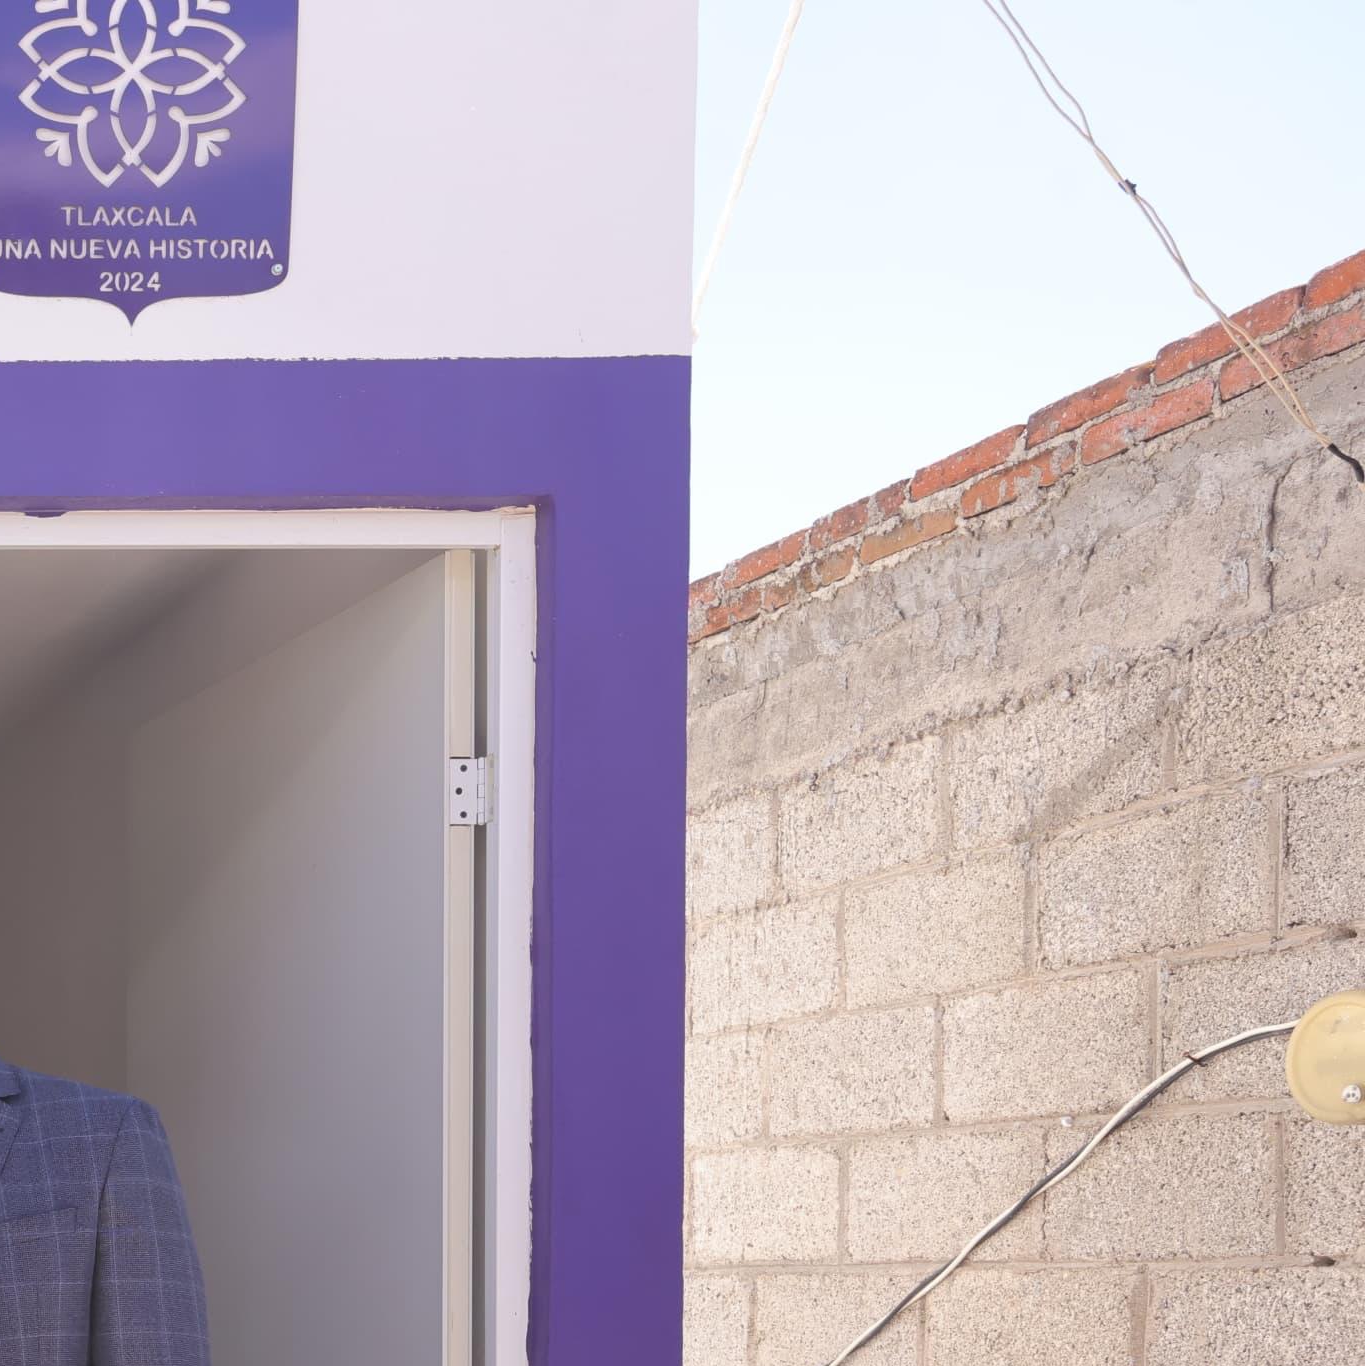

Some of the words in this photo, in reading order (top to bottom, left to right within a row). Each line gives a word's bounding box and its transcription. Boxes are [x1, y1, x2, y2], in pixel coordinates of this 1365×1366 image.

[60, 205, 198, 227] TLAXCALA
[50, 238, 141, 260] NUEVA
[149, 238, 275, 260] HISTORIA
[99, 271, 162, 293] 2024
